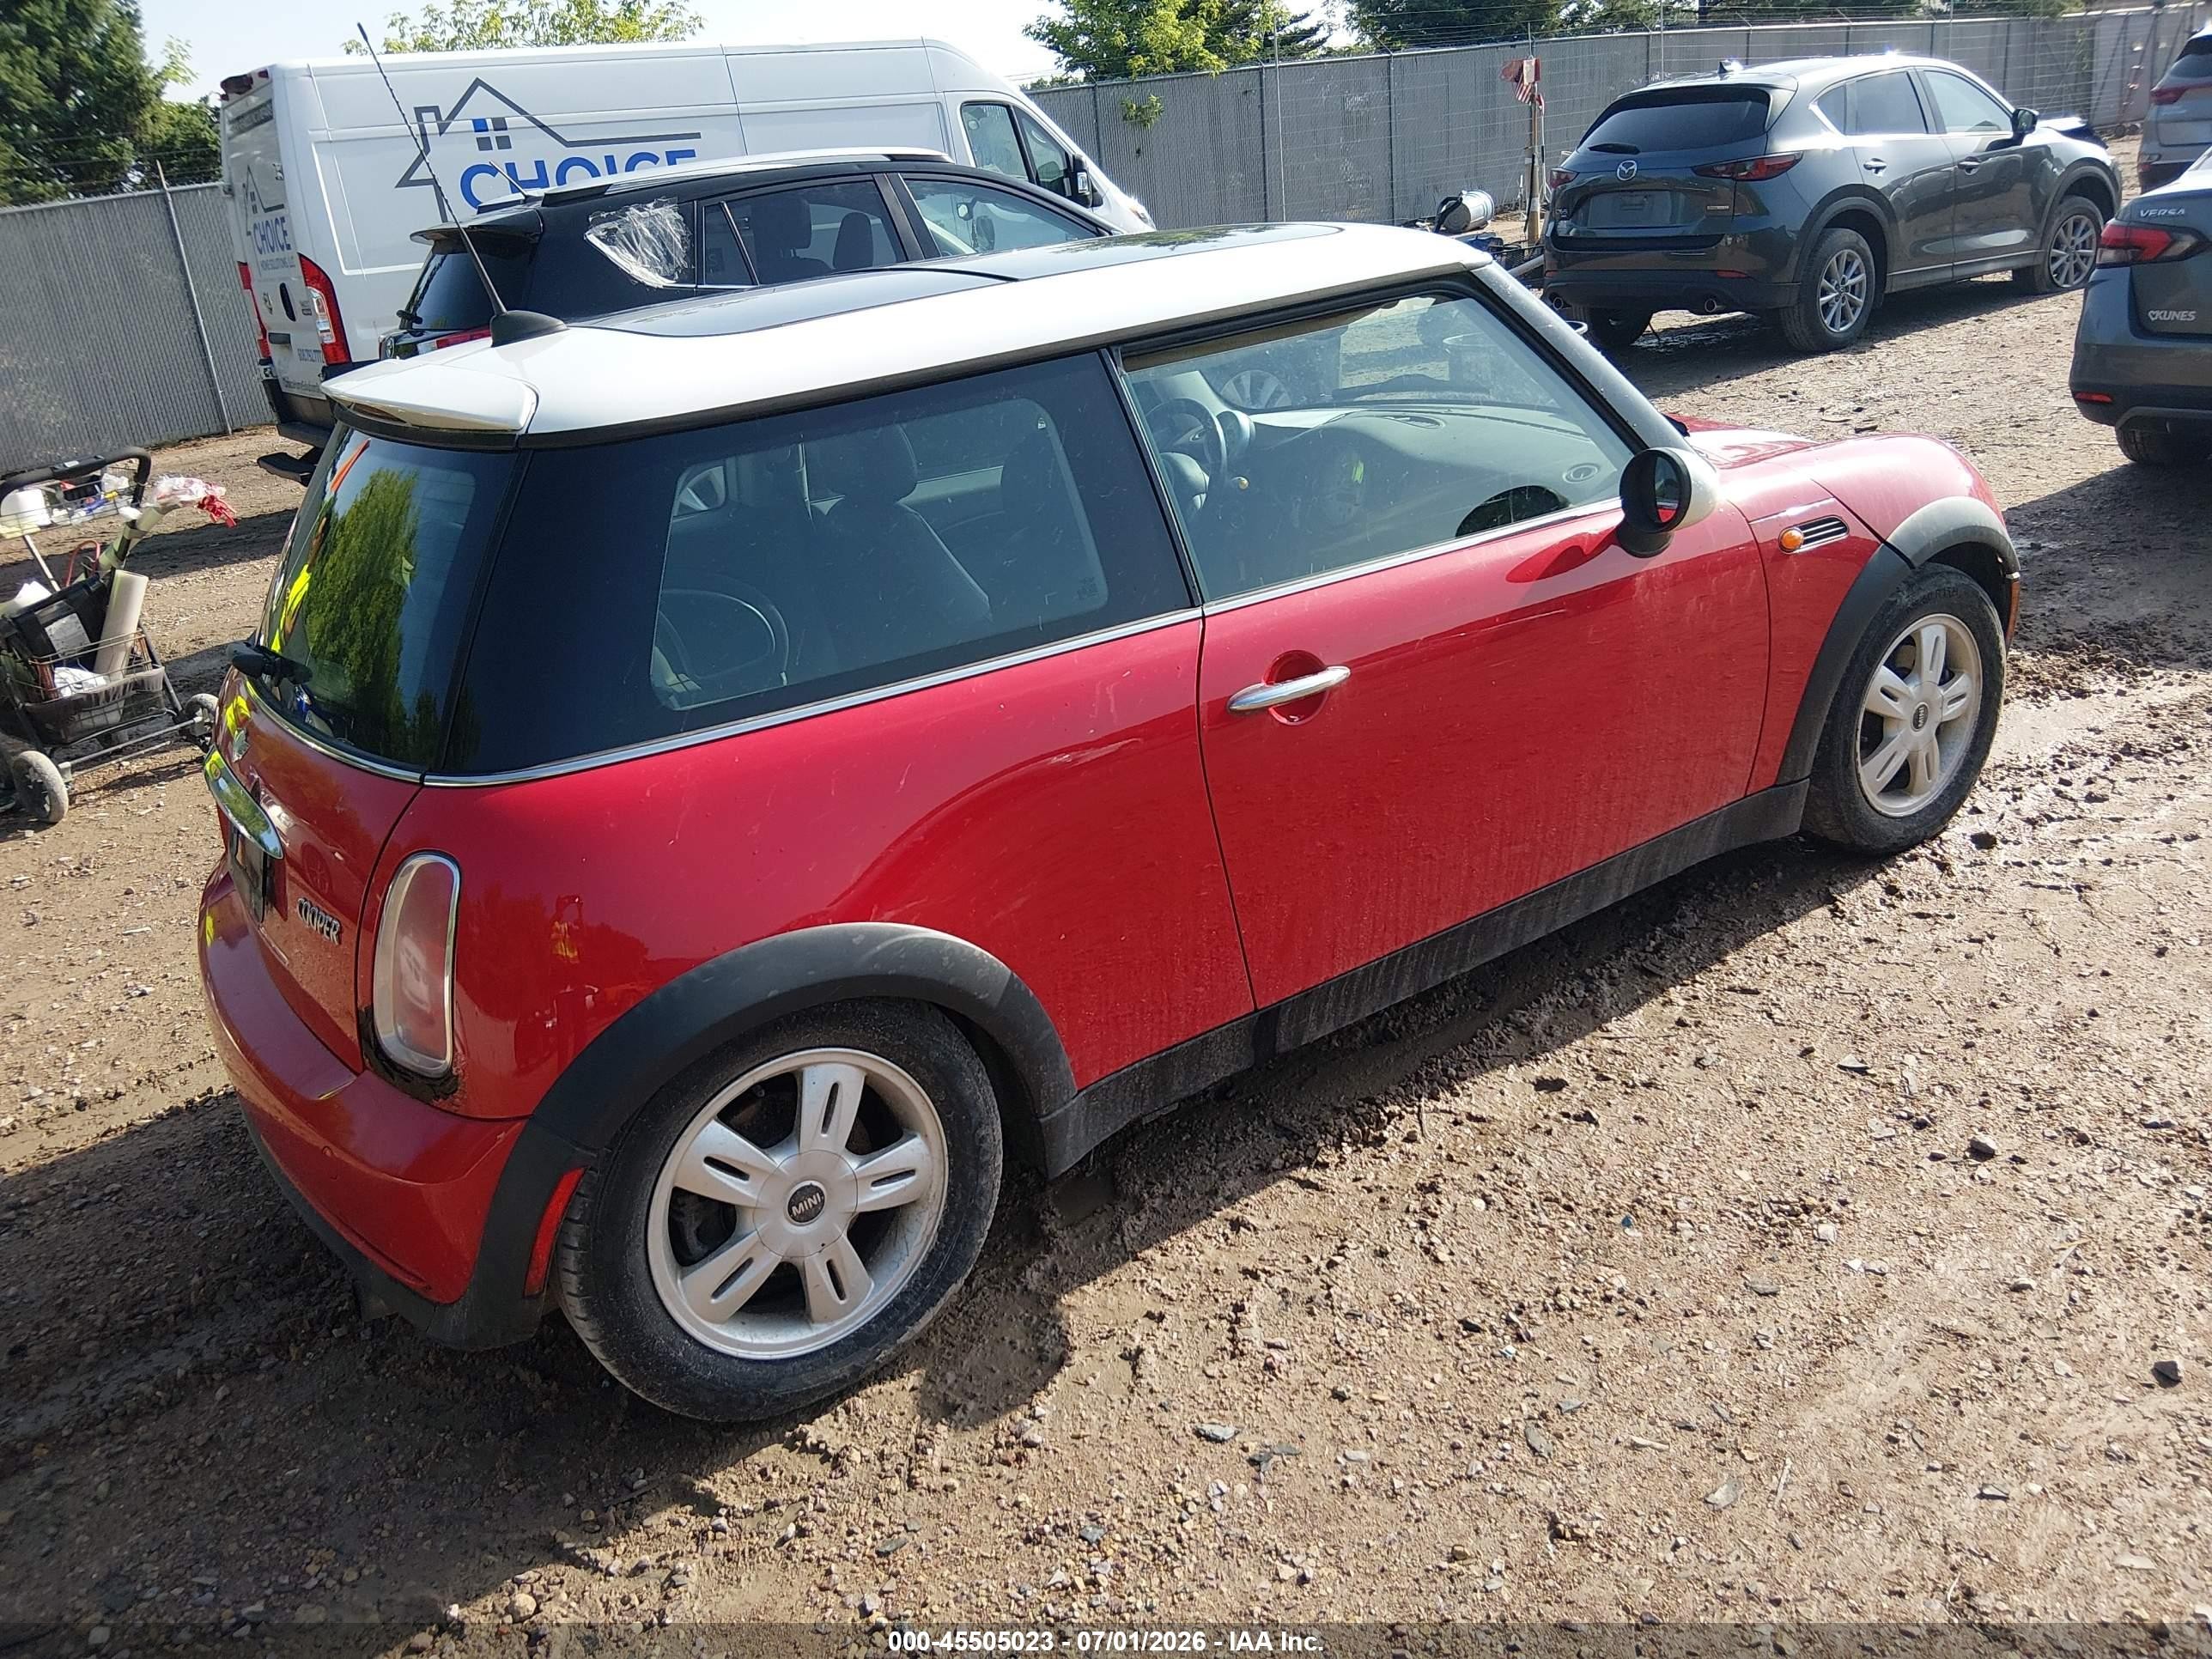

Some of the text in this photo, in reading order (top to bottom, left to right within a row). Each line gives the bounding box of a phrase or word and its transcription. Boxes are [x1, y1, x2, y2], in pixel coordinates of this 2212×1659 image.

[2140, 209, 2186, 218] VERSA
[252, 216, 292, 255] CHOICE
[2155, 310, 2197, 321] KUNES
[297, 897, 341, 945] COOPER
[792, 1192, 822, 1217] MINI
